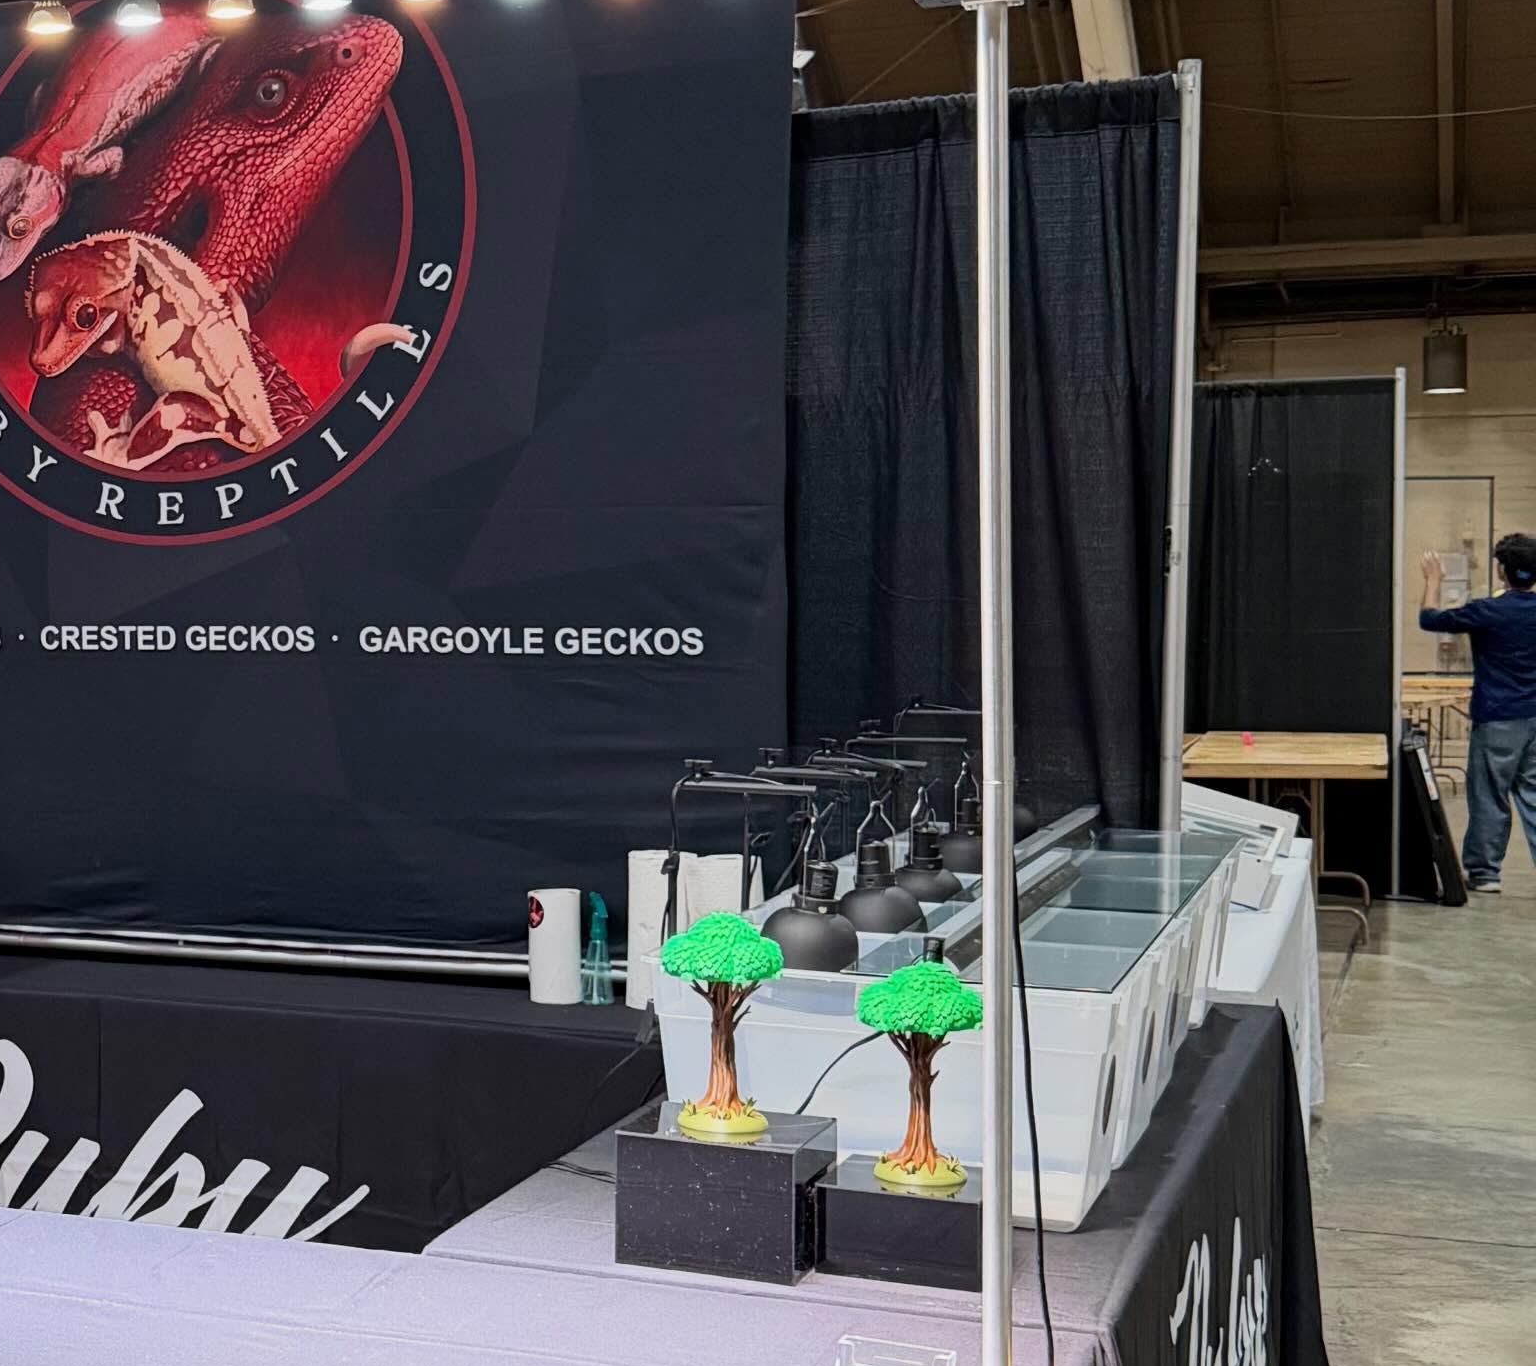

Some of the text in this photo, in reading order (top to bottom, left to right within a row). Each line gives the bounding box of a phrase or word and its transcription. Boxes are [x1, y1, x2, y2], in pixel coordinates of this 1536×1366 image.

[95, 261, 453, 525] REPTILES
[40, 624, 178, 652] CRESTED
[185, 624, 316, 653] GECKOS
[359, 625, 546, 655] GARGOYLE
[554, 627, 705, 657] GECKOS
